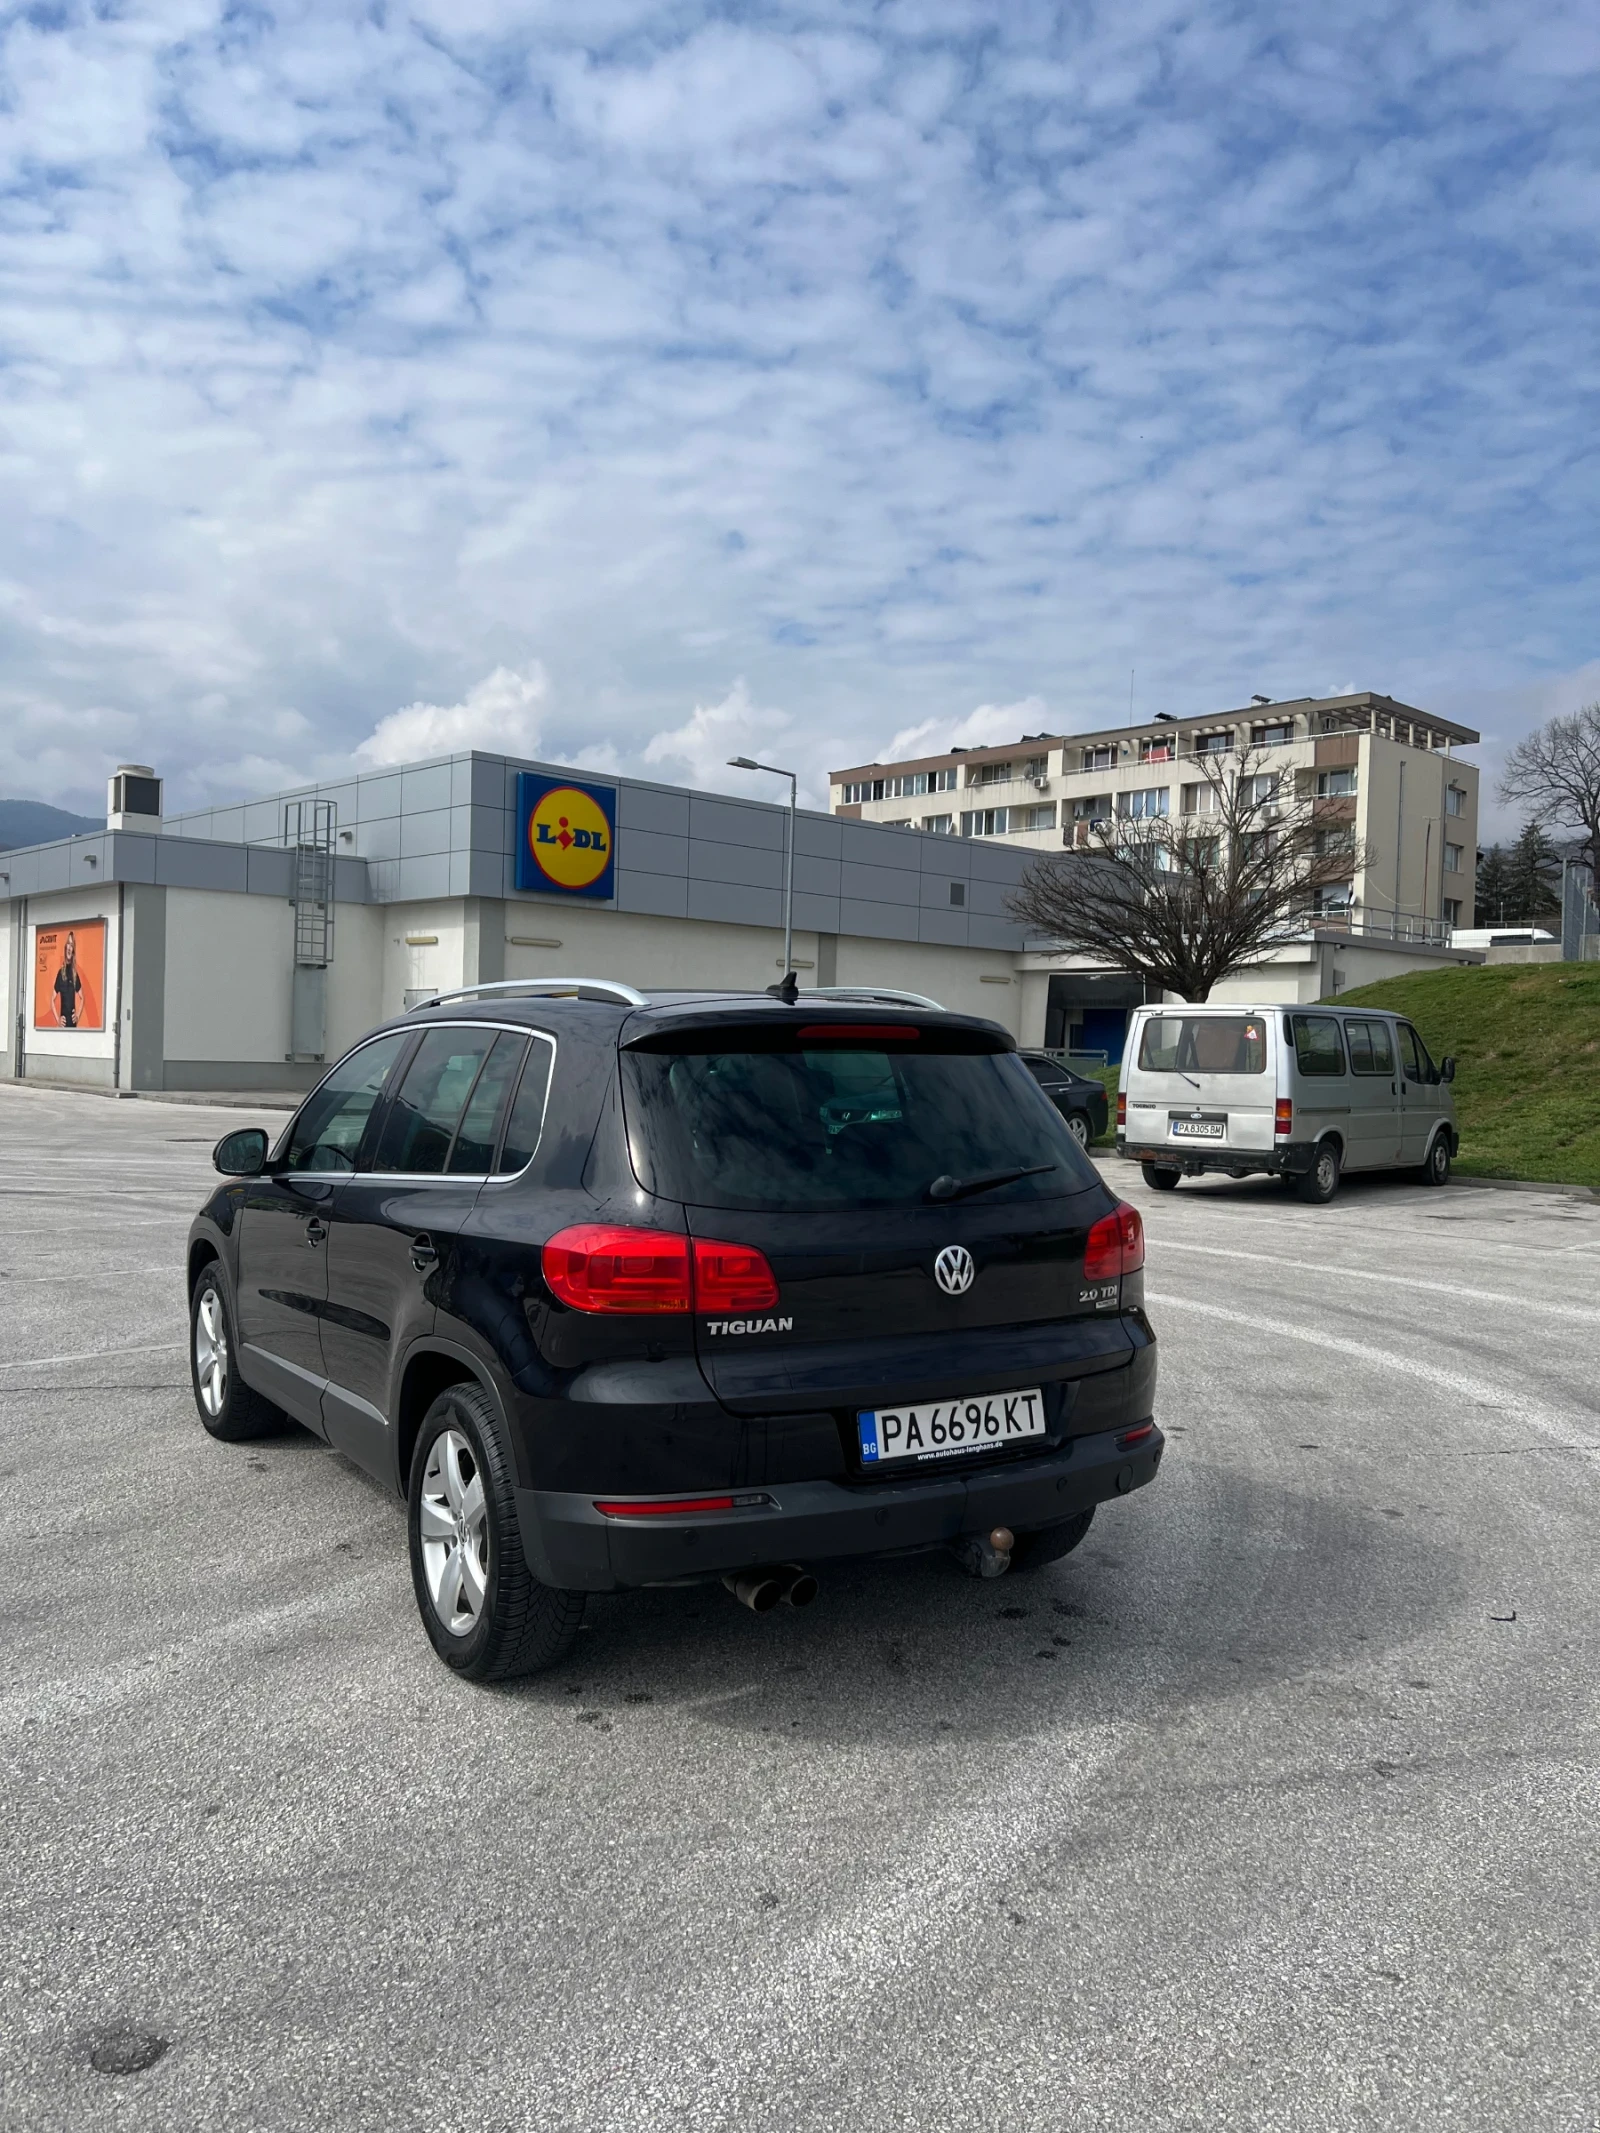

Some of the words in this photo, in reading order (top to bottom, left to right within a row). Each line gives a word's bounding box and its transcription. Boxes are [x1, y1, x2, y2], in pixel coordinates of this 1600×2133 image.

[1101, 1285, 1117, 1298] TDI
[707, 1317, 793, 1335] TIGUAN
[862, 1443, 877, 1455] BG
[917, 1441, 1003, 1461] www.autohaus-langhans.de
